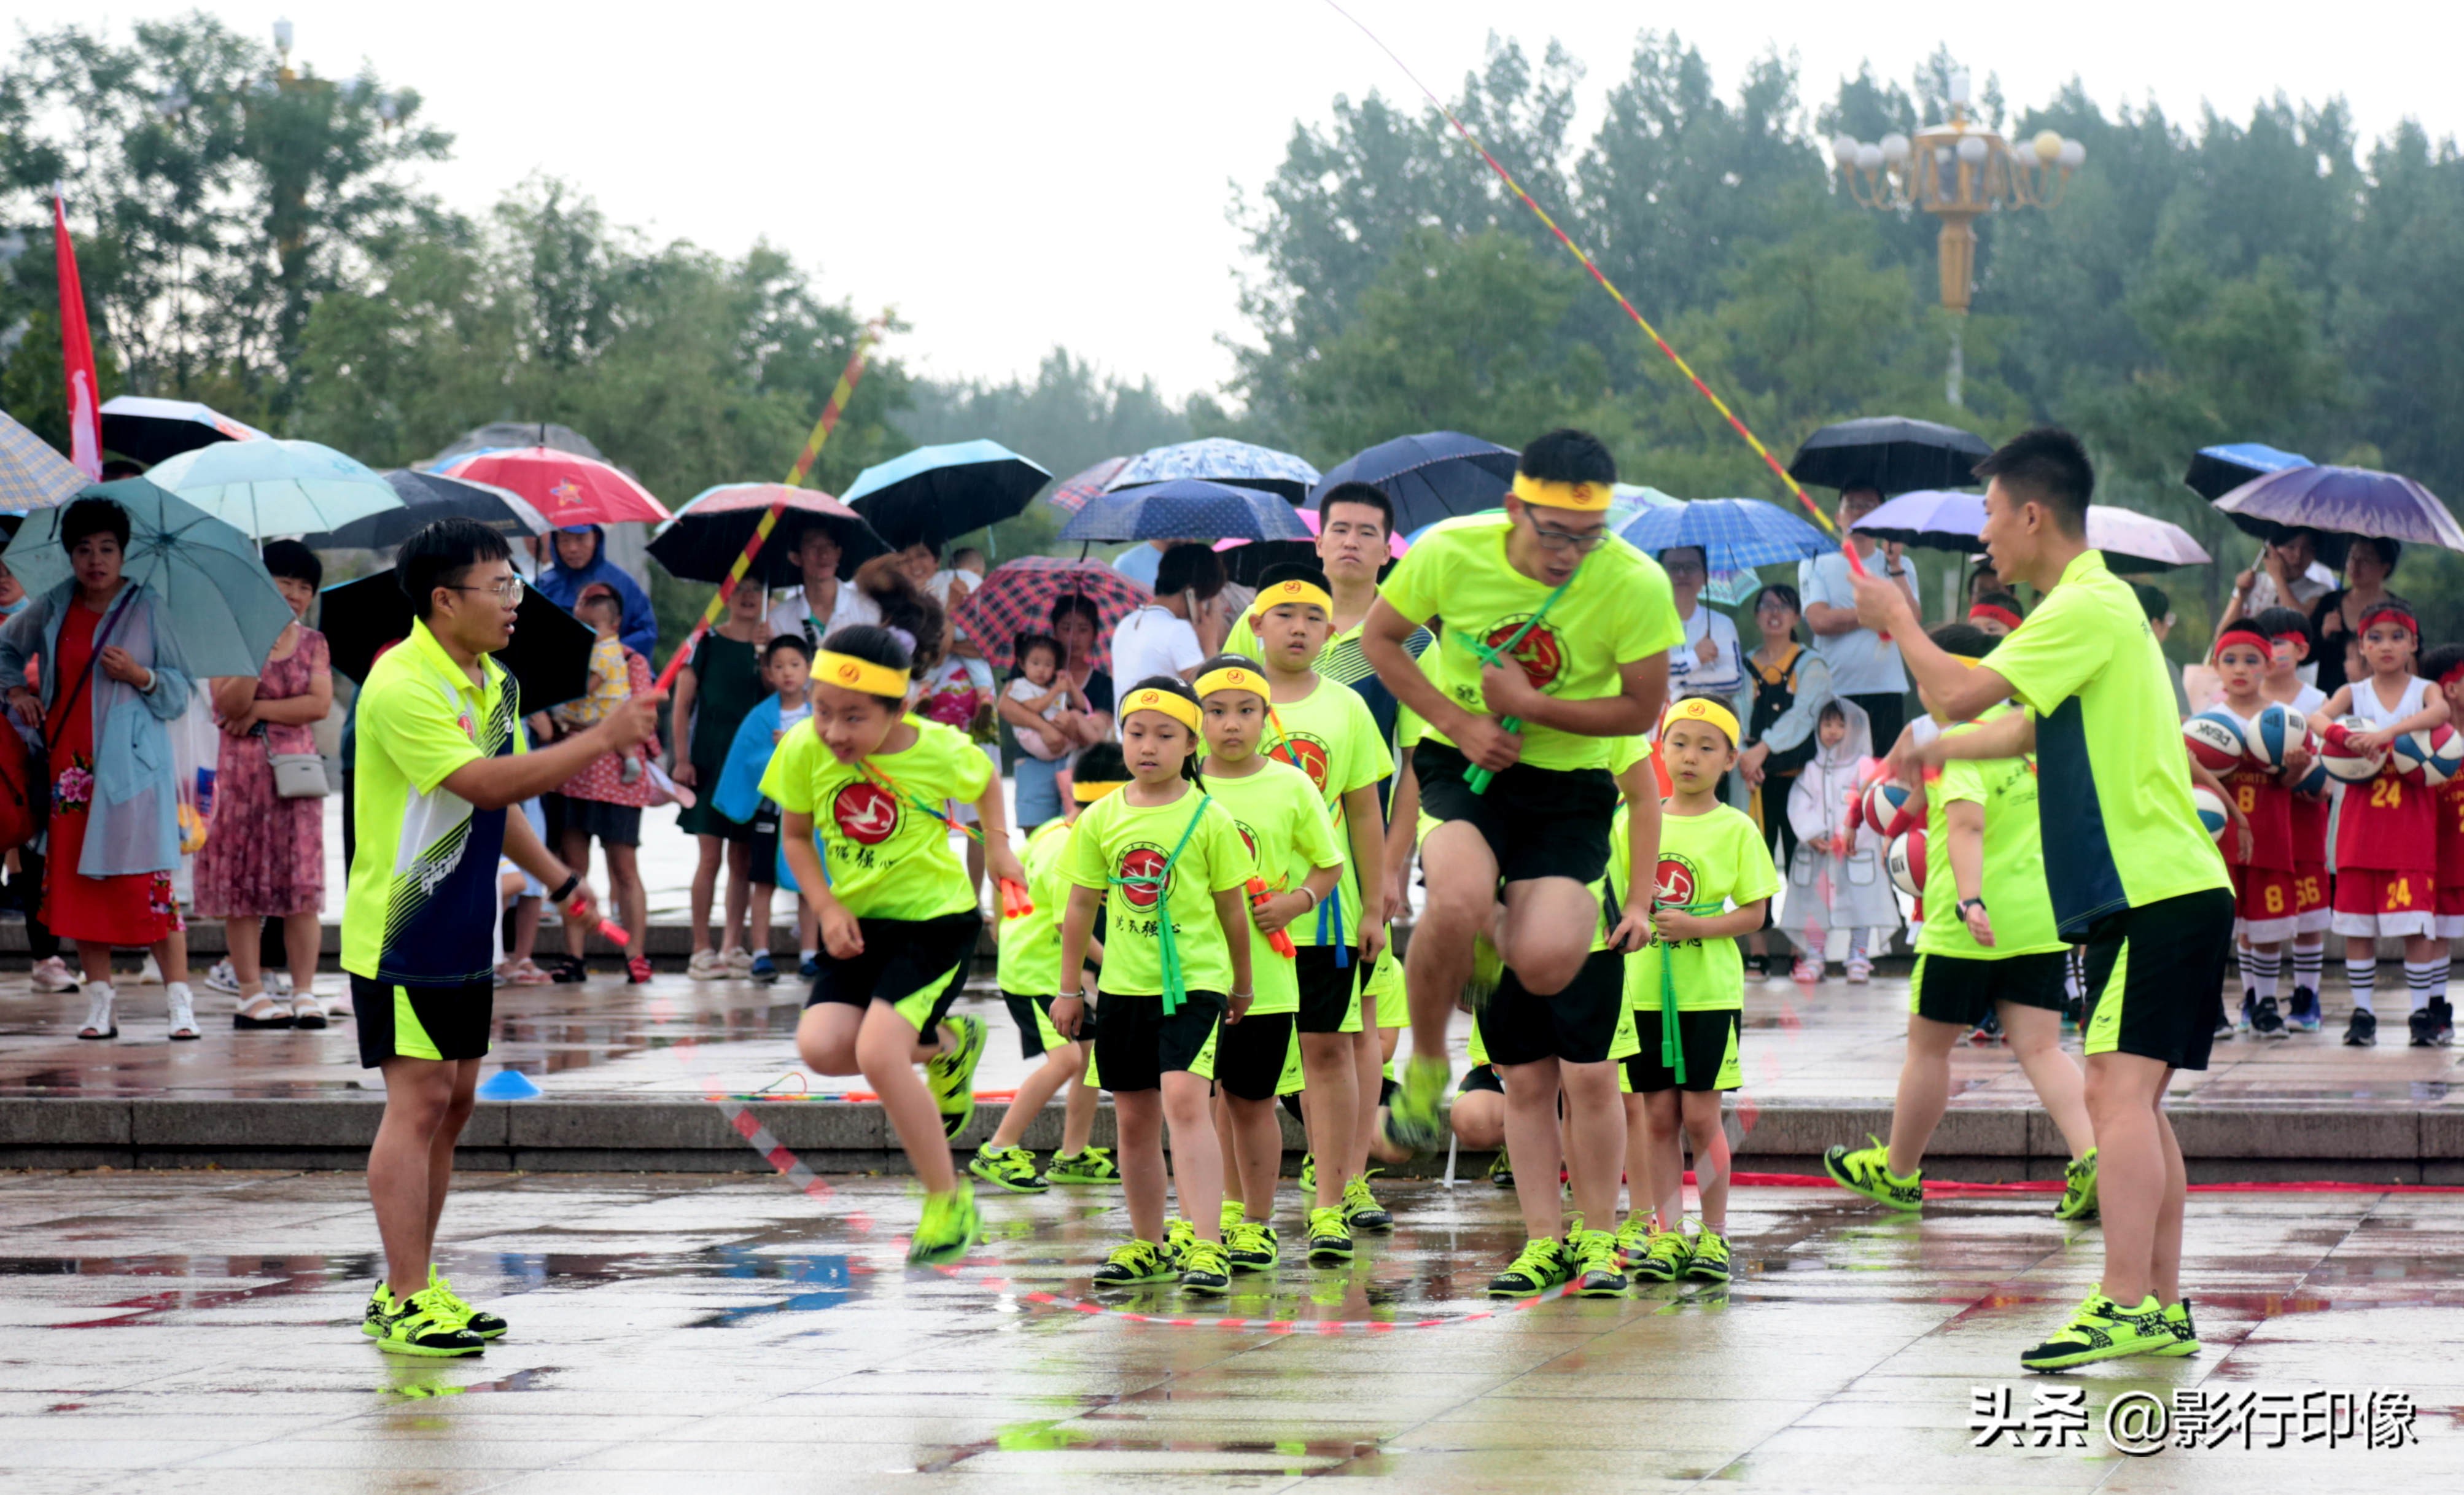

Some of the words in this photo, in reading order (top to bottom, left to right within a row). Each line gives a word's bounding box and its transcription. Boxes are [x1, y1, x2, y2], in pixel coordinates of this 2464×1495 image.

[2196, 723, 2231, 747] PEAK
[2238, 785, 2255, 813] 8
[2370, 778, 2402, 809] 24
[2264, 885, 2284, 913] 8
[2387, 877, 2412, 910] 24
